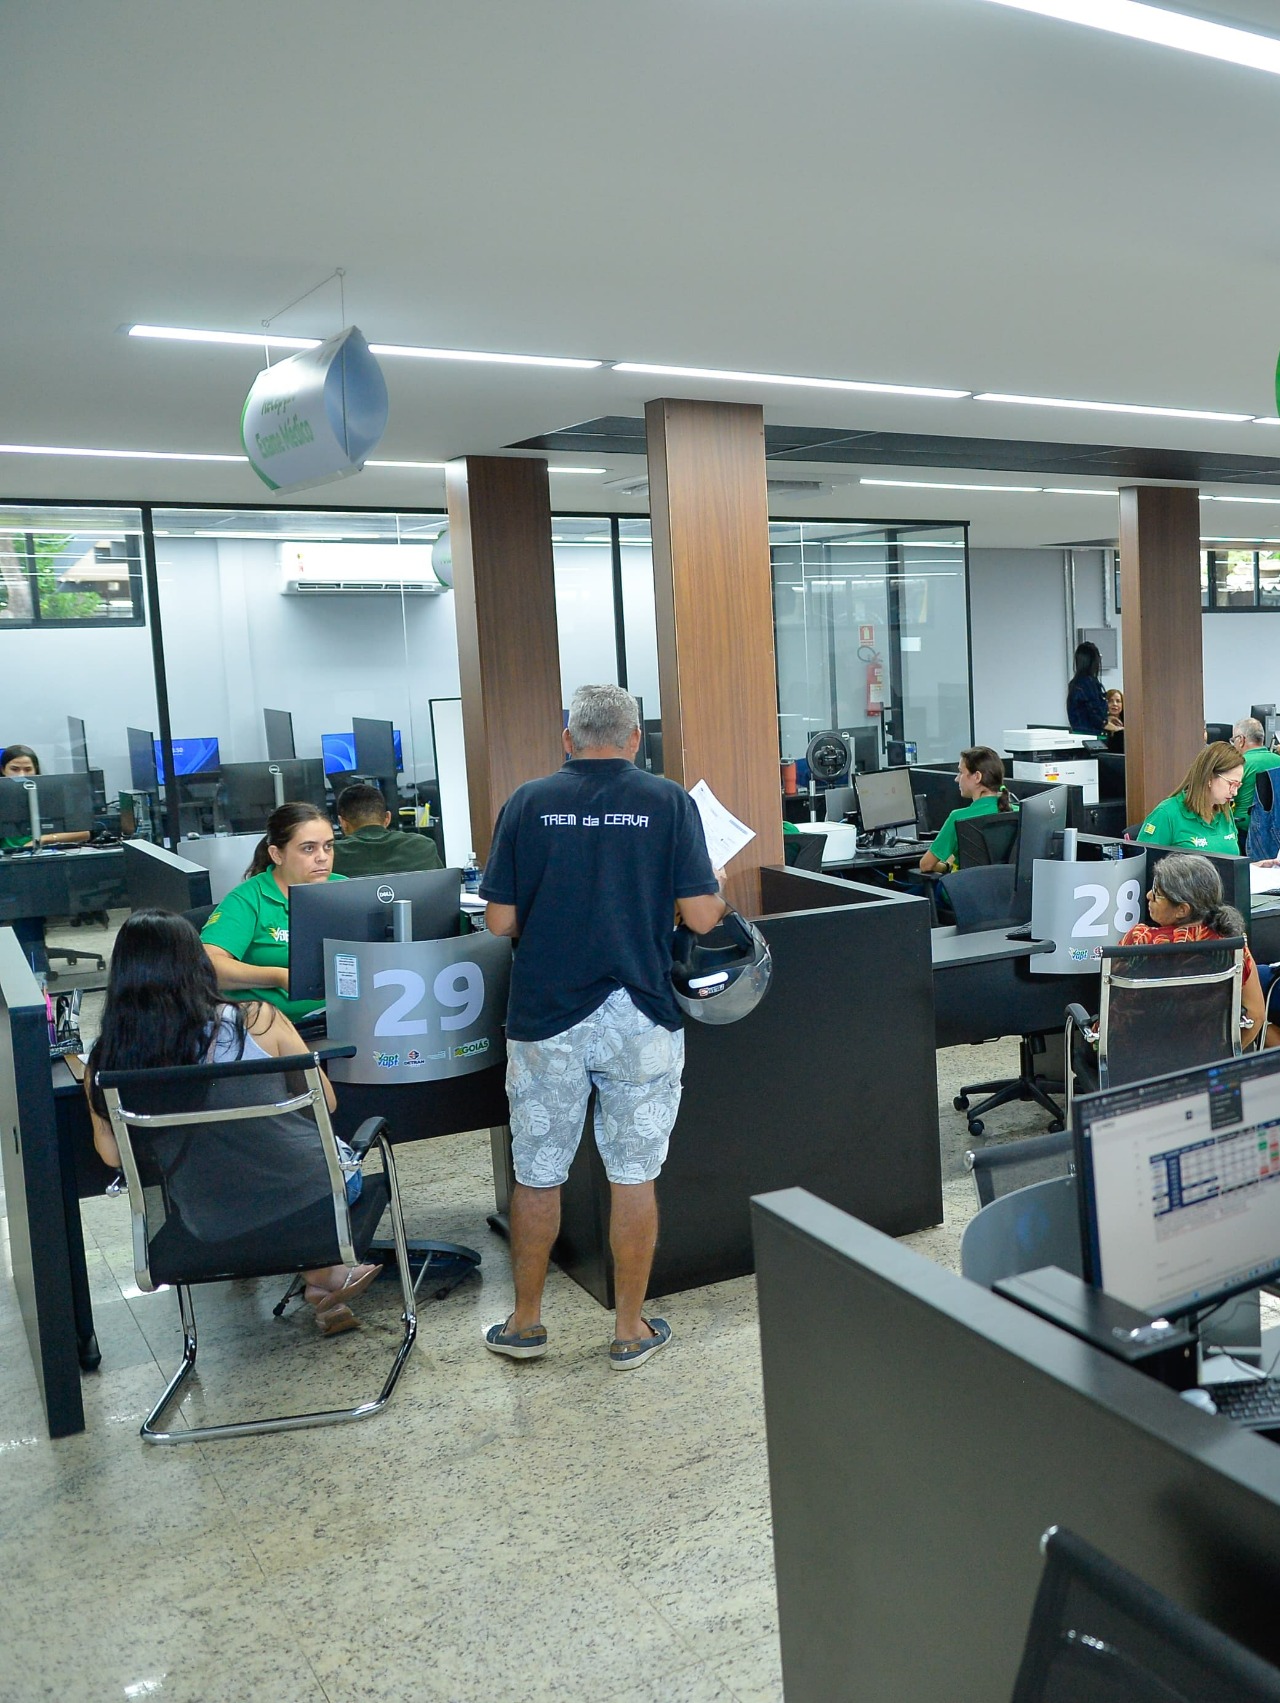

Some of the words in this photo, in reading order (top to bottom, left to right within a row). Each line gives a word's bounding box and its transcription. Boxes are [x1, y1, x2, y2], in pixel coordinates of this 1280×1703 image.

[540, 814, 577, 826] TREM
[582, 815, 600, 827] da
[604, 814, 649, 828] CERVA
[1071, 879, 1140, 938] 28
[373, 961, 485, 1037] 29
[461, 1040, 489, 1054] GOIÁS
[378, 1052, 399, 1061] Vapt
